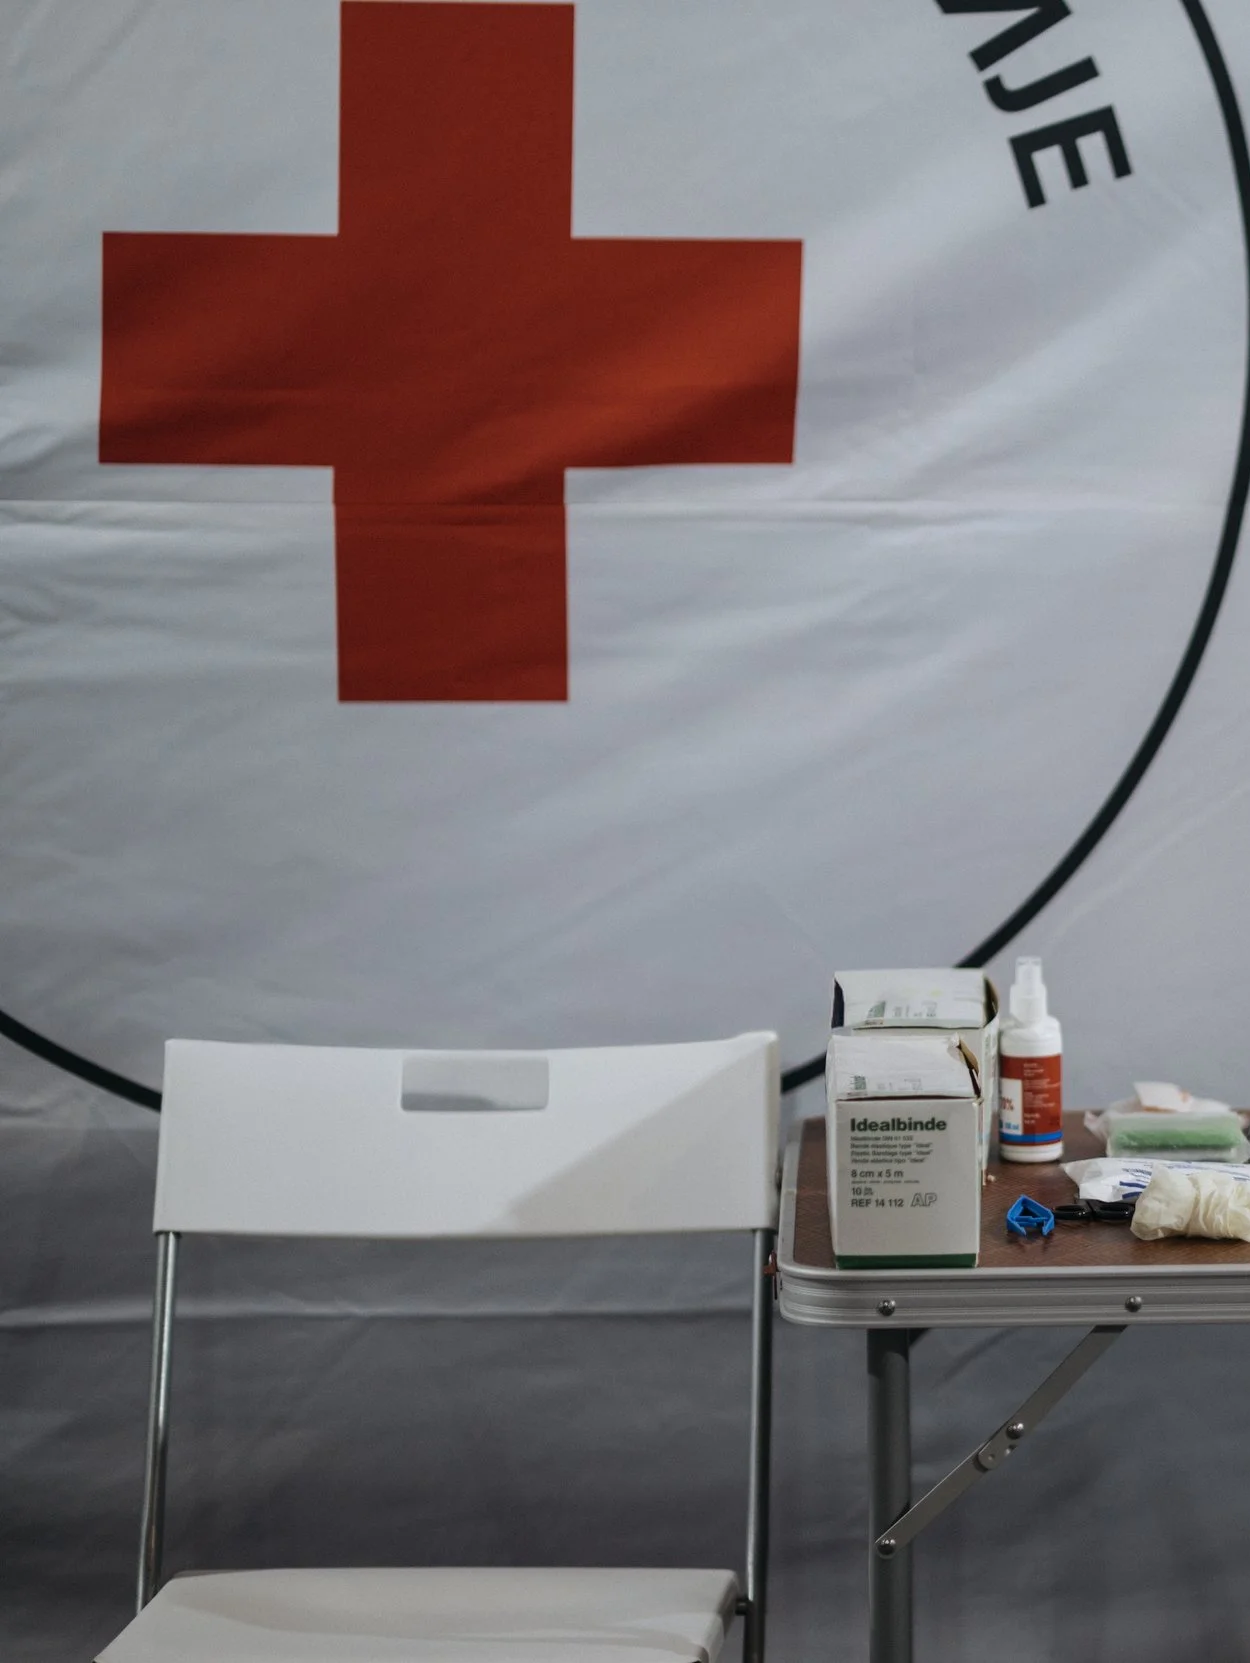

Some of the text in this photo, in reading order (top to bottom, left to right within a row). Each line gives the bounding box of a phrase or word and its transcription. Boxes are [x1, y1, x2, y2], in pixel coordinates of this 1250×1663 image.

[850, 1117, 947, 1132] Idealbinde
[851, 1169, 904, 1178] 8 cm x 5 m
[852, 1187, 862, 1196] 10
[851, 1199, 905, 1208] REF 14 112
[910, 1192, 937, 1207] AP
